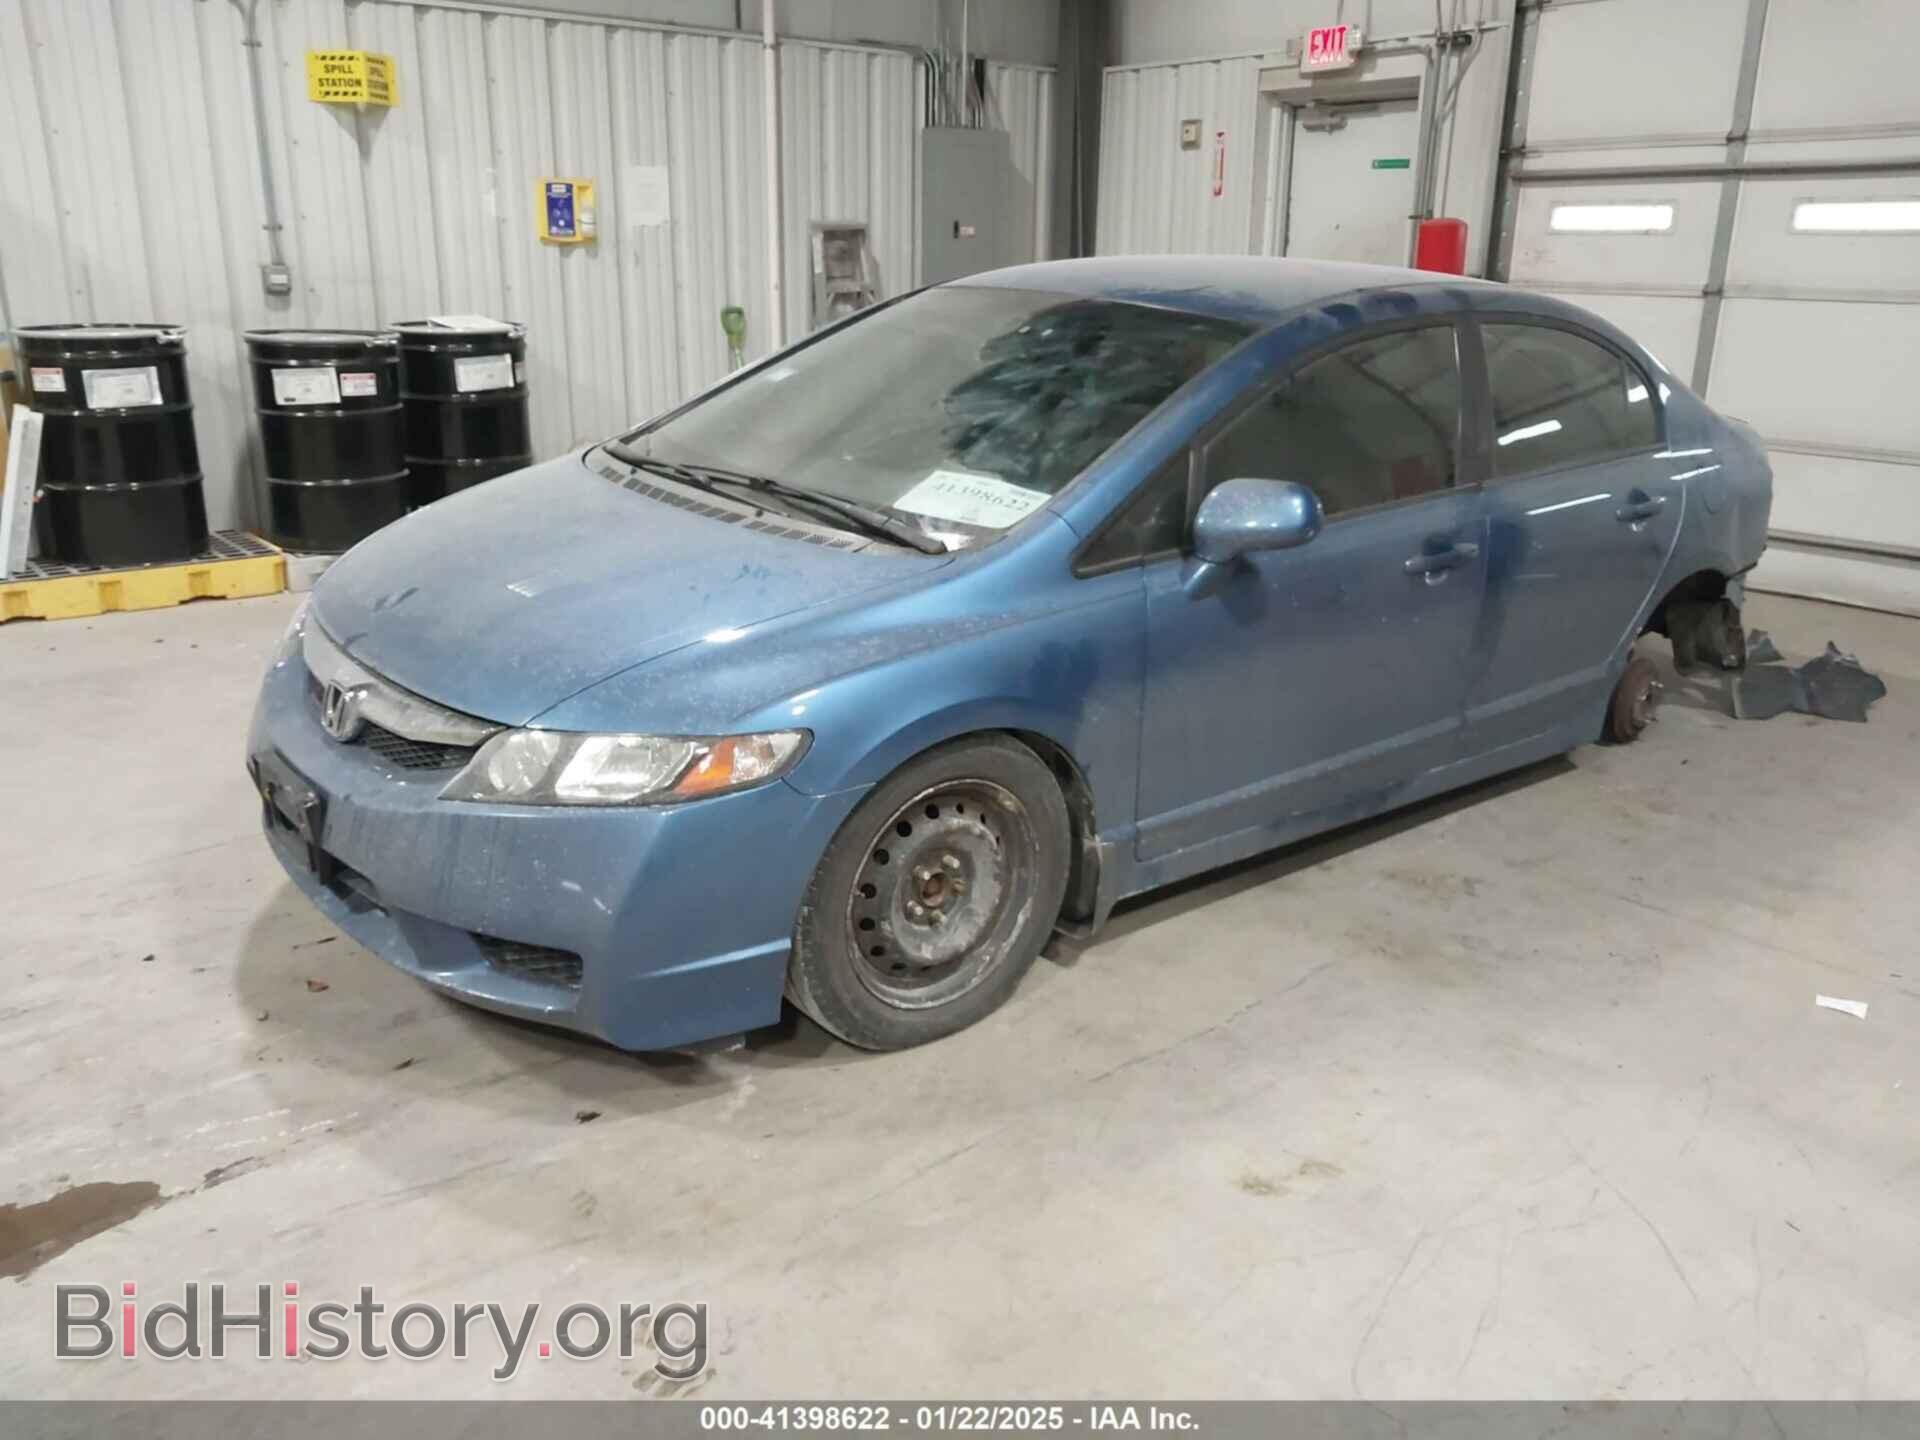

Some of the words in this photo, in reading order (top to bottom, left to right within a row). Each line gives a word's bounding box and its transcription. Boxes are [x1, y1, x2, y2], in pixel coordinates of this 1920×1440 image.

[1310, 26, 1347, 54] EXIT
[323, 63, 354, 74] SPILL
[318, 78, 362, 88] STATION
